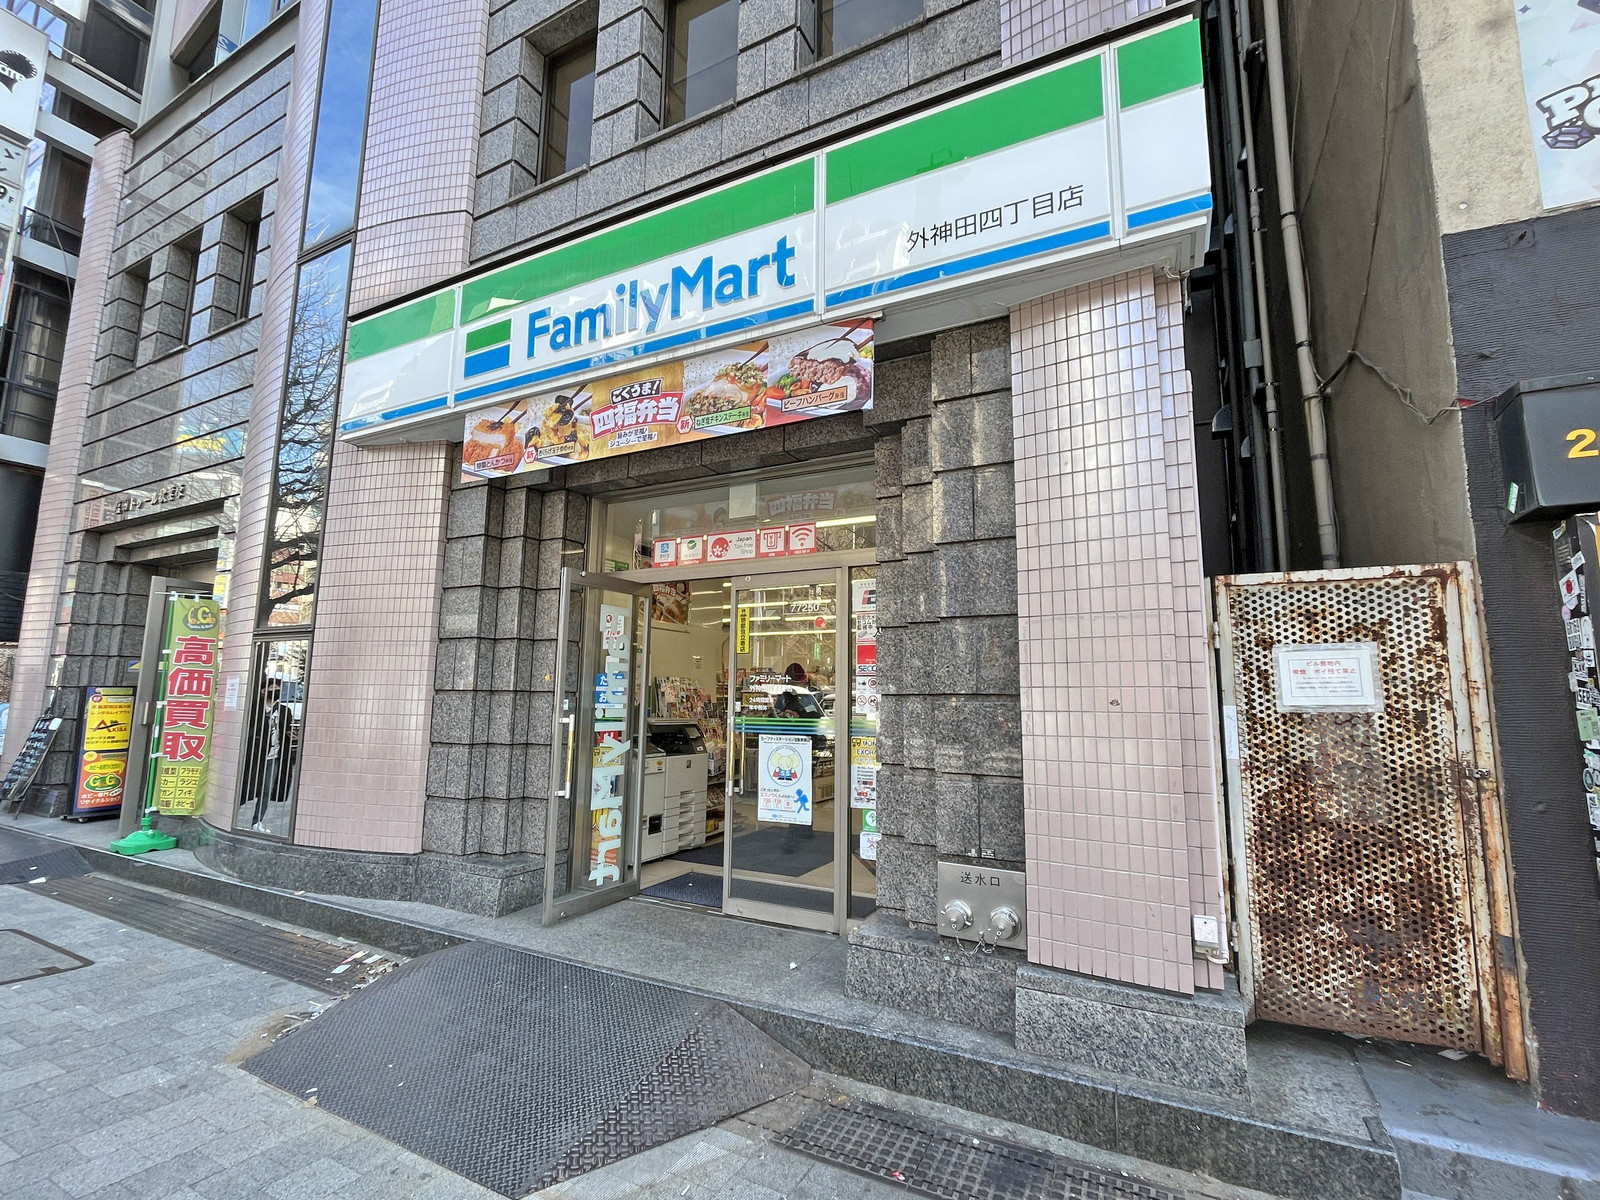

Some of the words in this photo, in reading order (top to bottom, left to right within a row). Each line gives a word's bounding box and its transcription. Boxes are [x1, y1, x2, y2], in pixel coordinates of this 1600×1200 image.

[907, 184, 1084, 253] 外神田四丁目店
[527, 235, 797, 360] FamilyMart
[592, 397, 680, 434] 四福弁当
[680, 418, 690, 431] 新
[526, 449, 534, 460] 新
[735, 536, 753, 544] Japan
[791, 603, 820, 612] 77250
[749, 675, 792, 683] ファミリーマート
[162, 635, 217, 762] 高価買取
[960, 871, 1000, 887] 送水口
